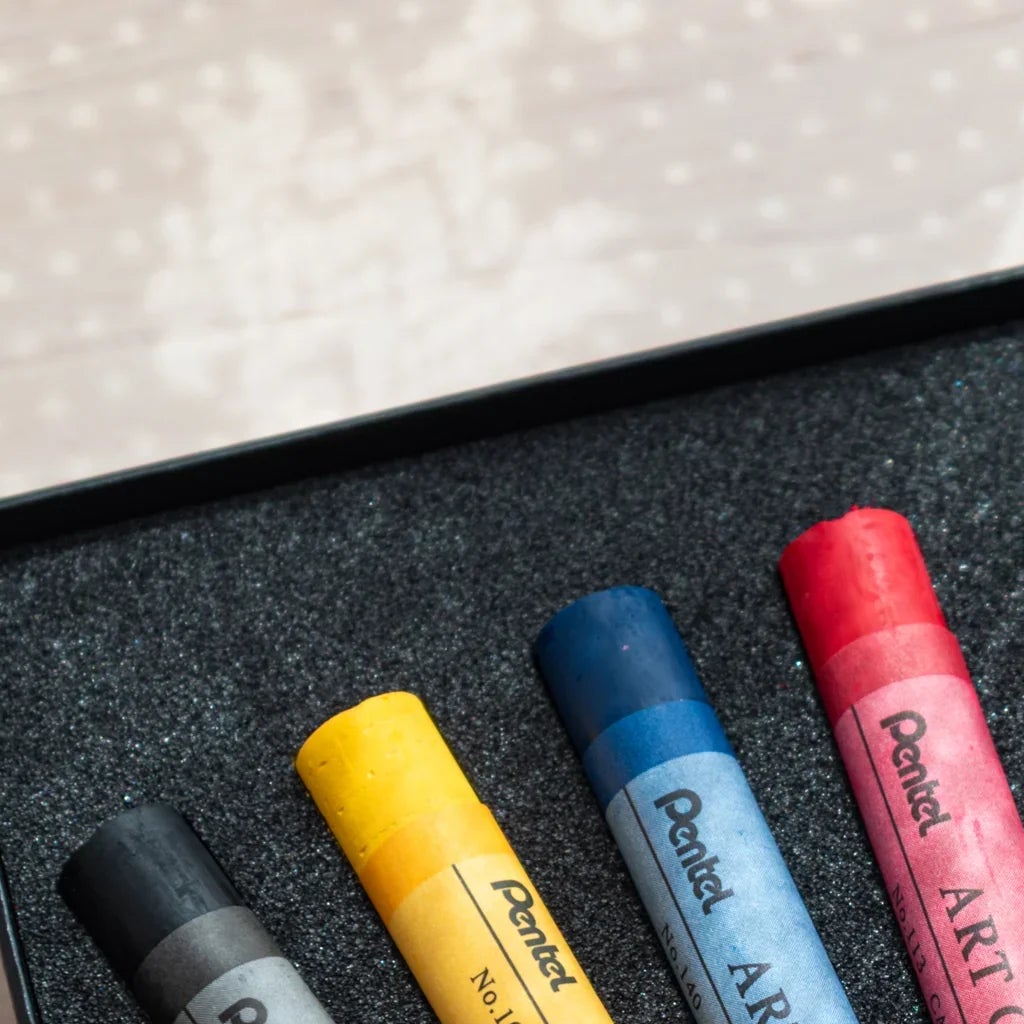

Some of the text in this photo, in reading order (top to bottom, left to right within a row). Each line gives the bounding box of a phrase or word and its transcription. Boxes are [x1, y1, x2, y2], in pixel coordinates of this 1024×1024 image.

[880, 710, 951, 837] Pentel
[654, 788, 733, 915] Pentel
[490, 880, 576, 992] Pentel
[661, 923, 701, 1010] No.140
[892, 883, 926, 973] No.113
[940, 886, 1013, 987] ART
